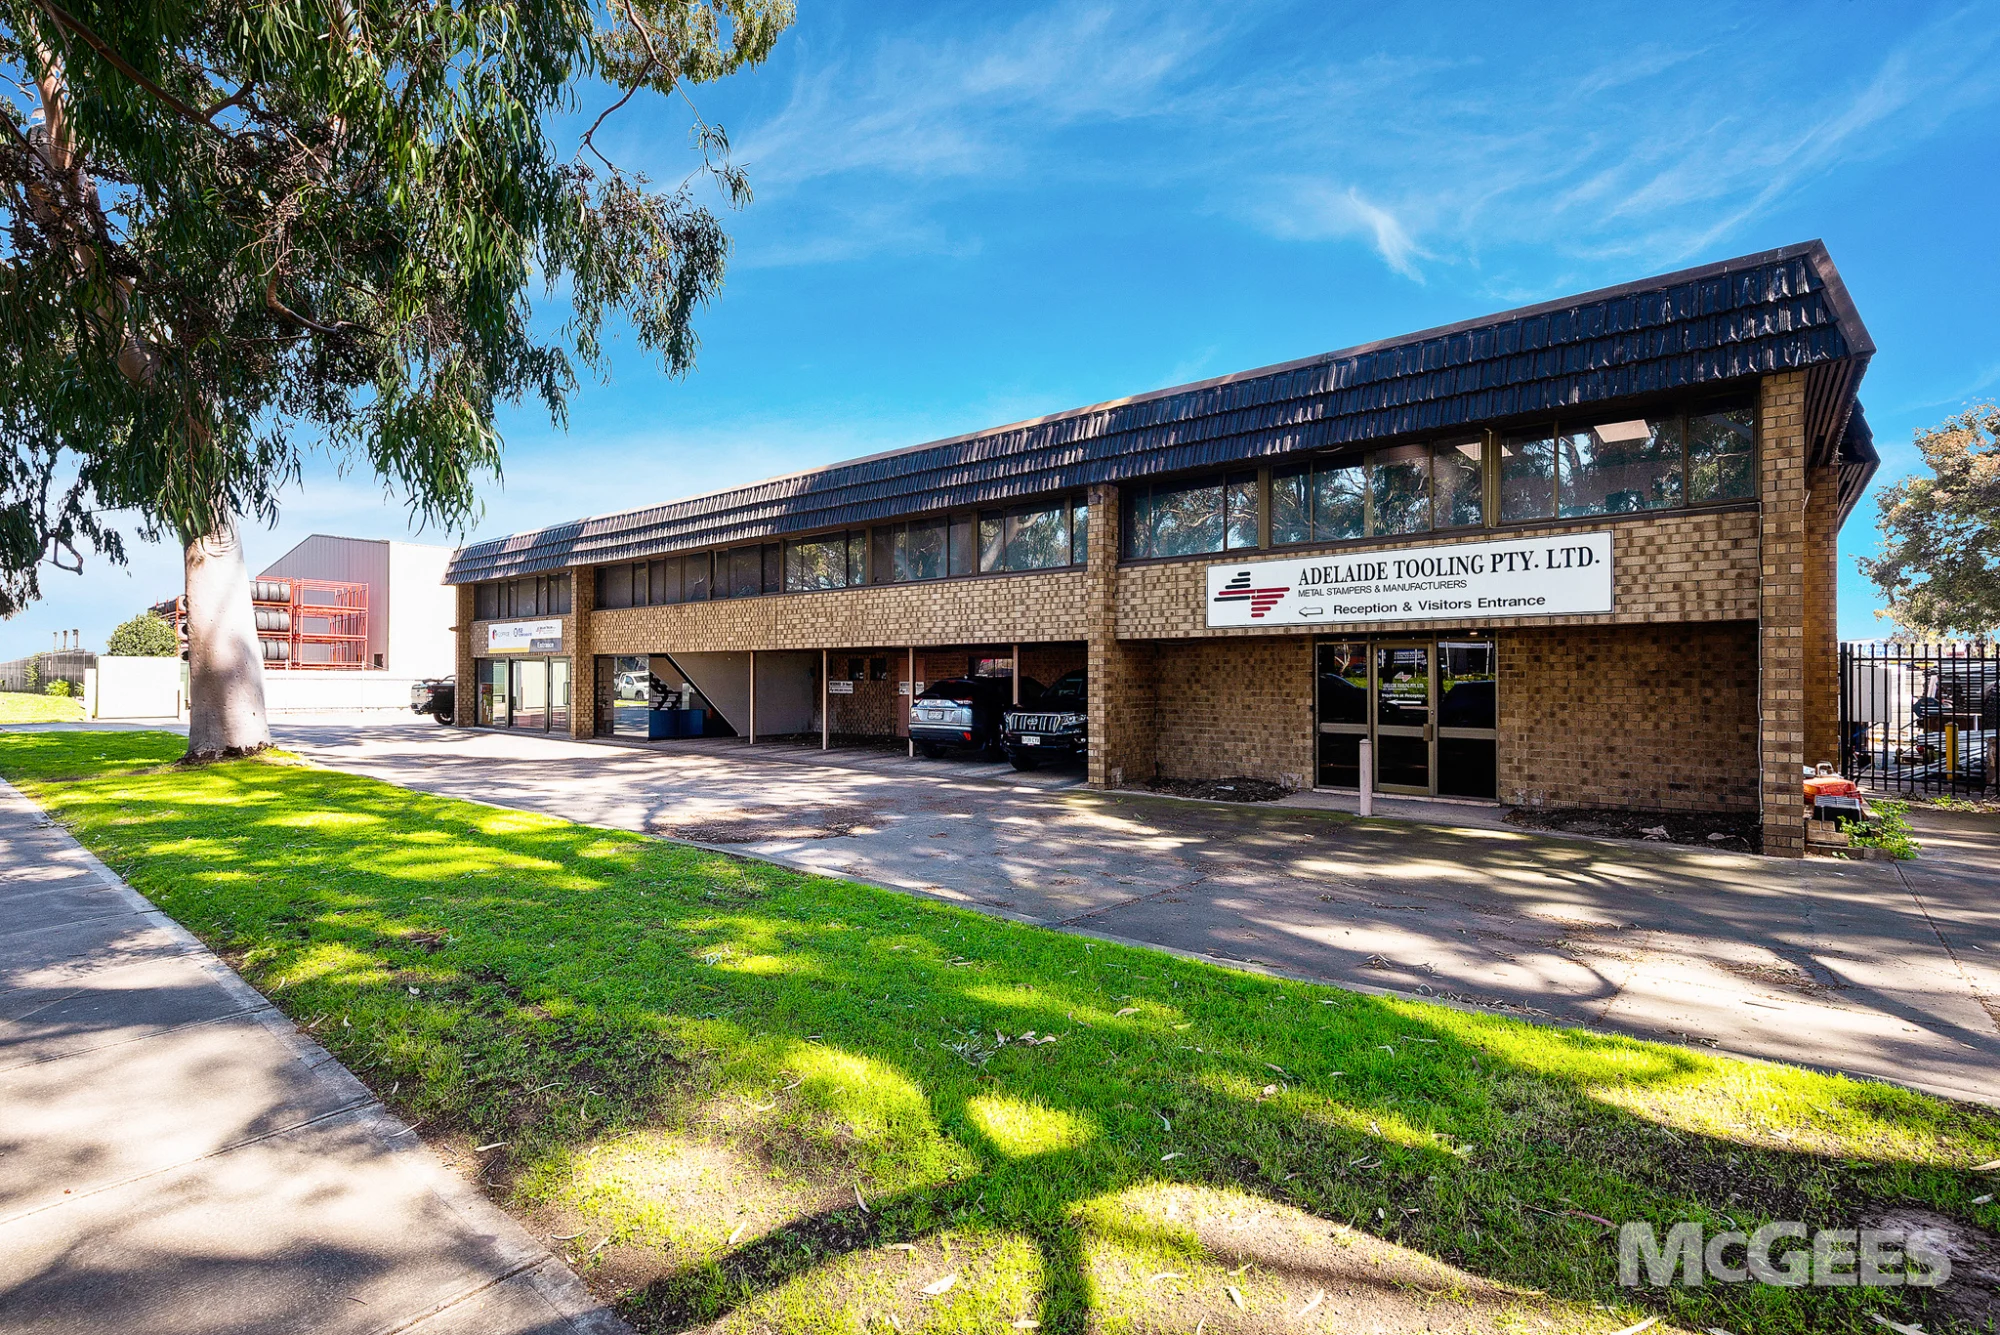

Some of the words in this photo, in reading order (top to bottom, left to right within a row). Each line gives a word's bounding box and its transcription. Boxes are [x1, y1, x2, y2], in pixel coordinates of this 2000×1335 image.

[1298, 561, 1388, 586] ADELAIDE
[1393, 554, 1485, 579] TOOLING
[1490, 550, 1539, 573] PTY.
[1546, 546, 1600, 569] LTD.
[1298, 588, 1325, 598] METAL
[1326, 585, 1373, 597] STAMPERS
[1374, 584, 1381, 594] &
[1383, 579, 1468, 593] MANUFACTURERS
[1333, 602, 1398, 616] Reception
[1402, 601, 1413, 612] &
[1418, 599, 1472, 611] Visitors
[1478, 596, 1546, 609] Entrance
